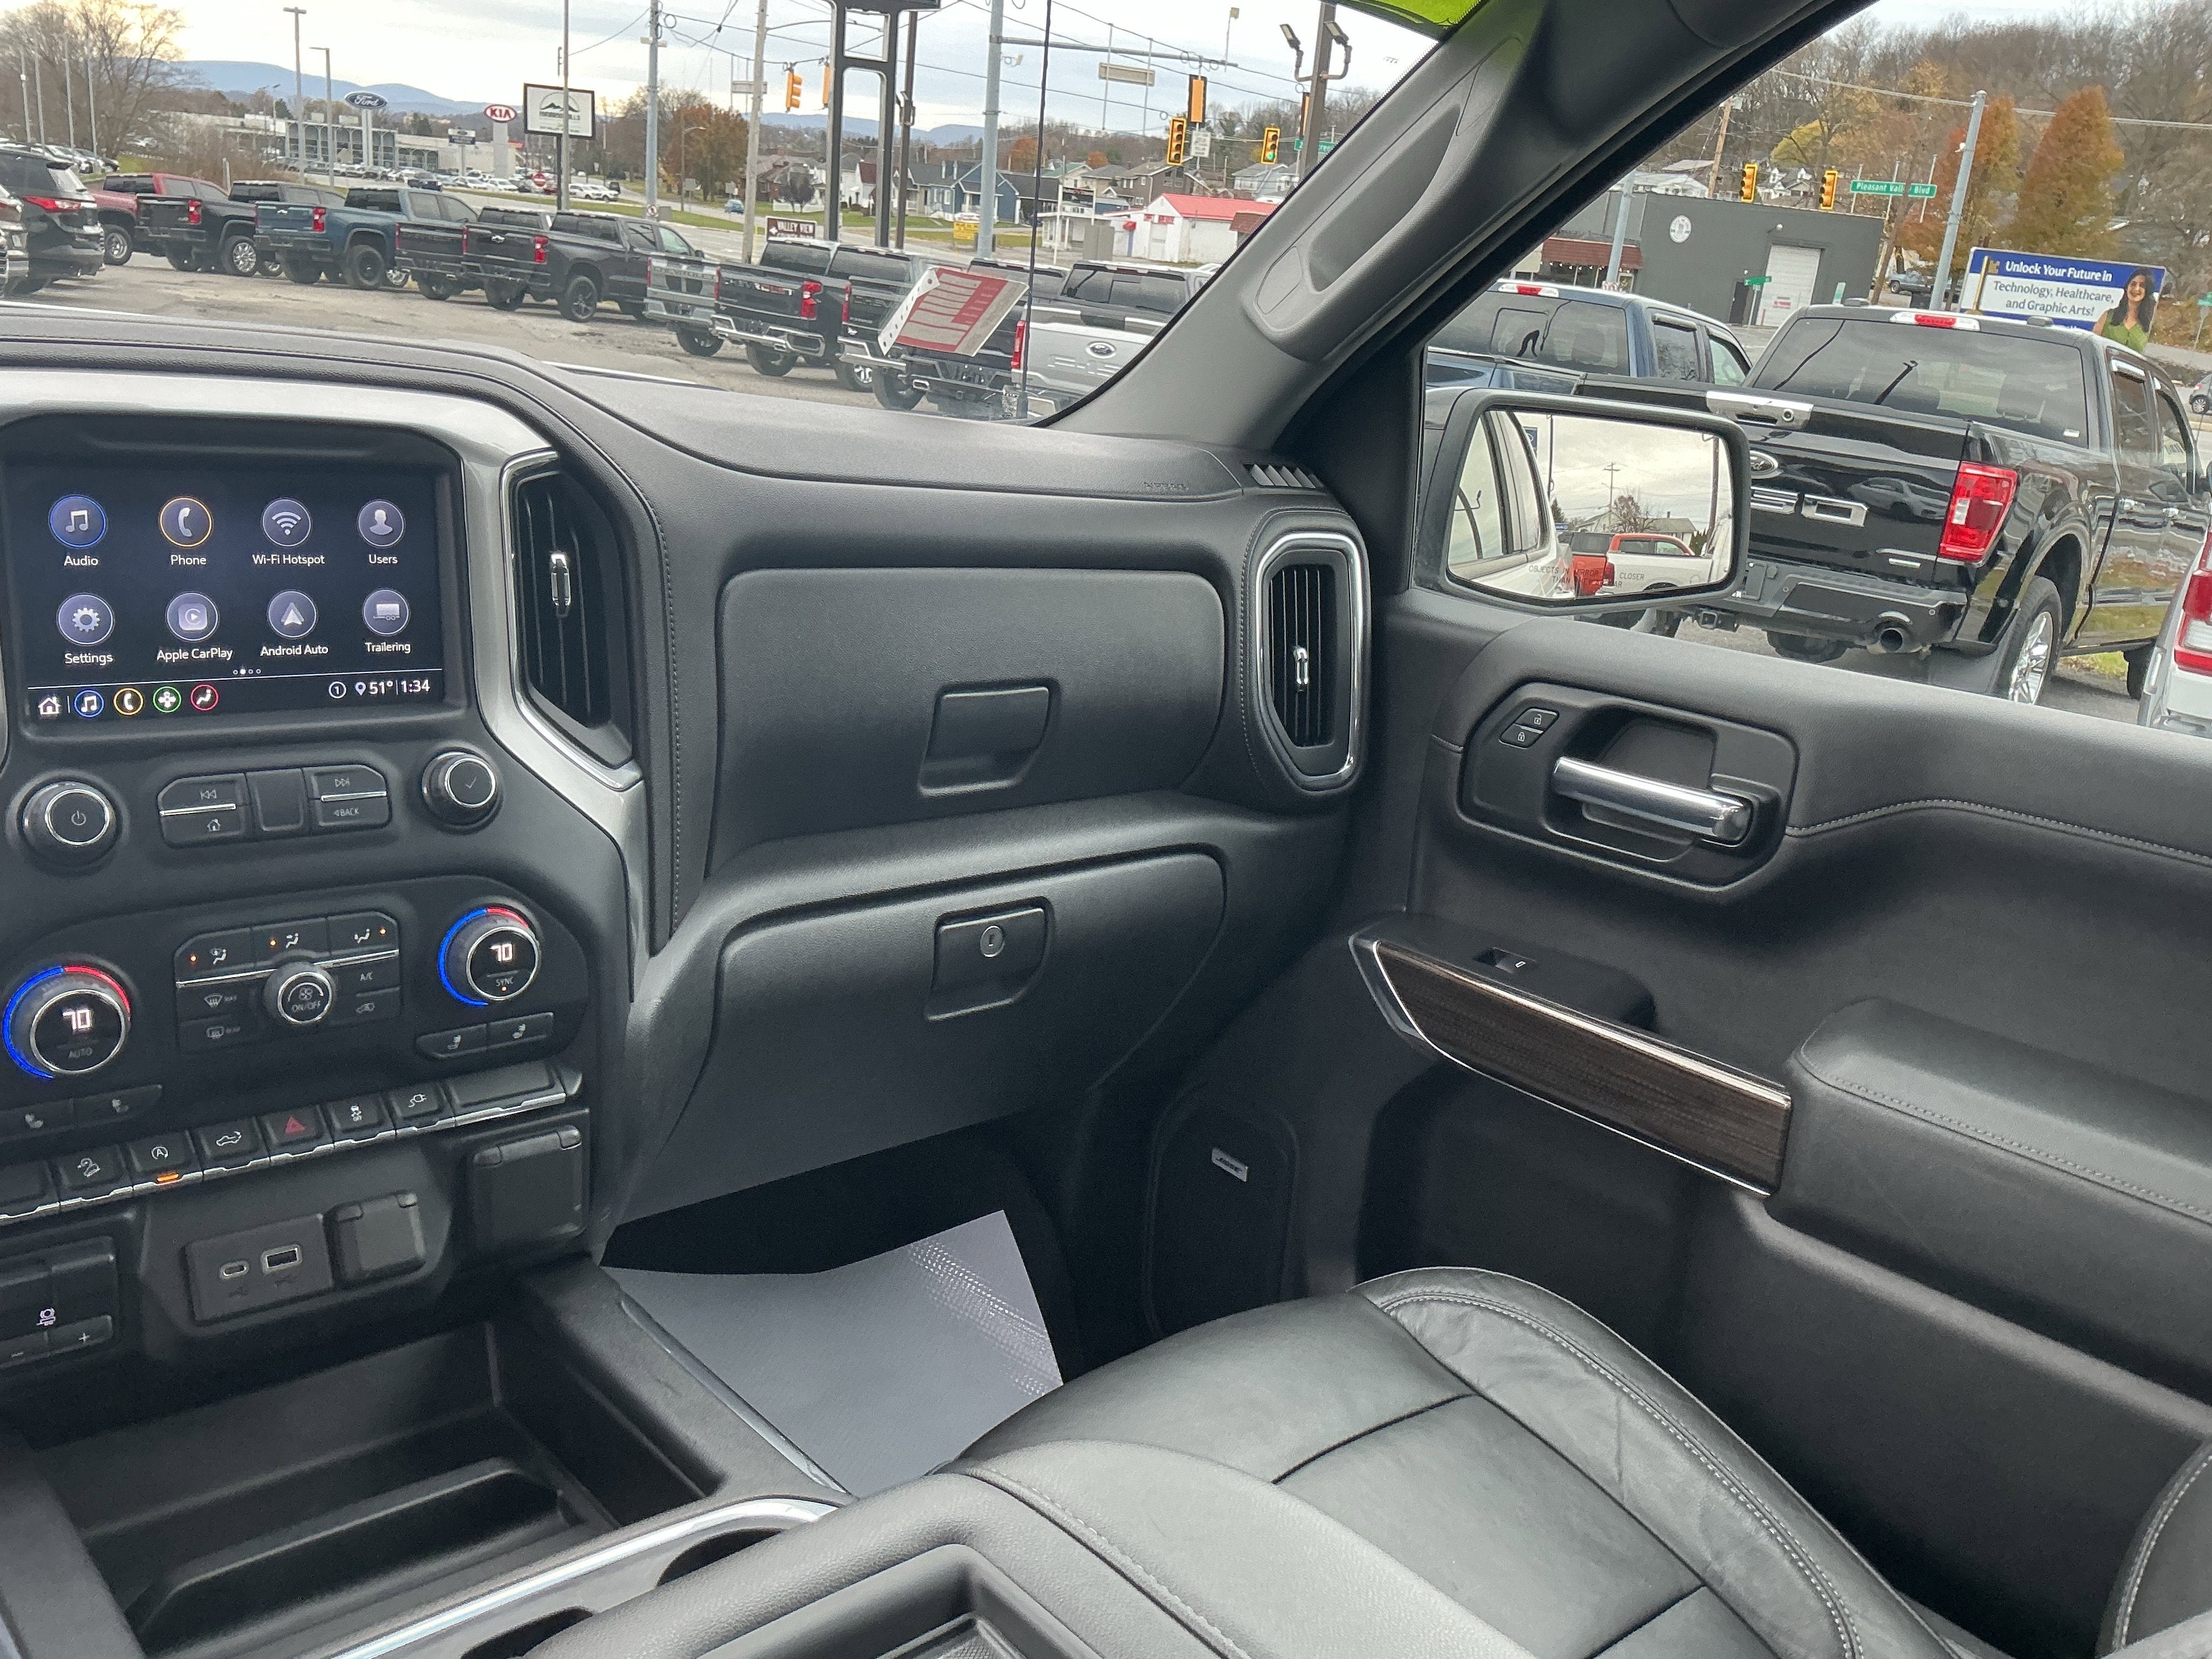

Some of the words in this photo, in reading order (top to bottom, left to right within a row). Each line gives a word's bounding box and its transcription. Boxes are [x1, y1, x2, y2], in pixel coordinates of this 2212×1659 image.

[354, 94, 379, 106] Ford
[490, 108, 511, 119] KIA
[1857, 182, 1886, 191] Pleasant
[1889, 184, 1905, 193] Vall
[1915, 185, 1931, 194] Blvd
[2005, 261, 2041, 275] Unlock
[2044, 264, 2066, 278] Your
[2067, 267, 2101, 281] Future
[2102, 270, 2113, 282] in
[1994, 280, 2053, 298] Technology,
[2056, 287, 2114, 303] Healthcare,
[2006, 298, 2025, 309] and
[2028, 302, 2067, 315] Graphic
[2068, 304, 2095, 317] Arts!
[64, 555, 98, 566] Audio
[171, 555, 206, 566] Phone
[252, 554, 280, 565] Wi-Fi
[283, 554, 325, 567] Hotspot
[369, 554, 398, 565] Users
[1528, 565, 1560, 574] OBJECTS
[1620, 572, 1645, 581] CLOSER
[260, 645, 302, 657] Android
[304, 645, 329, 655] Auto
[365, 642, 411, 654] Trailering
[64, 653, 113, 665] Settings
[157, 649, 188, 663] Apple
[192, 648, 233, 661] CarPlay
[369, 680, 393, 695] 51°
[401, 679, 431, 693] 1:34
[340, 808, 359, 817] BACK
[490, 942, 514, 962] 70
[360, 971, 374, 982] A/C
[496, 977, 514, 987] SYNC
[291, 1001, 321, 1013] ON/OFF
[63, 1008, 92, 1030] 70
